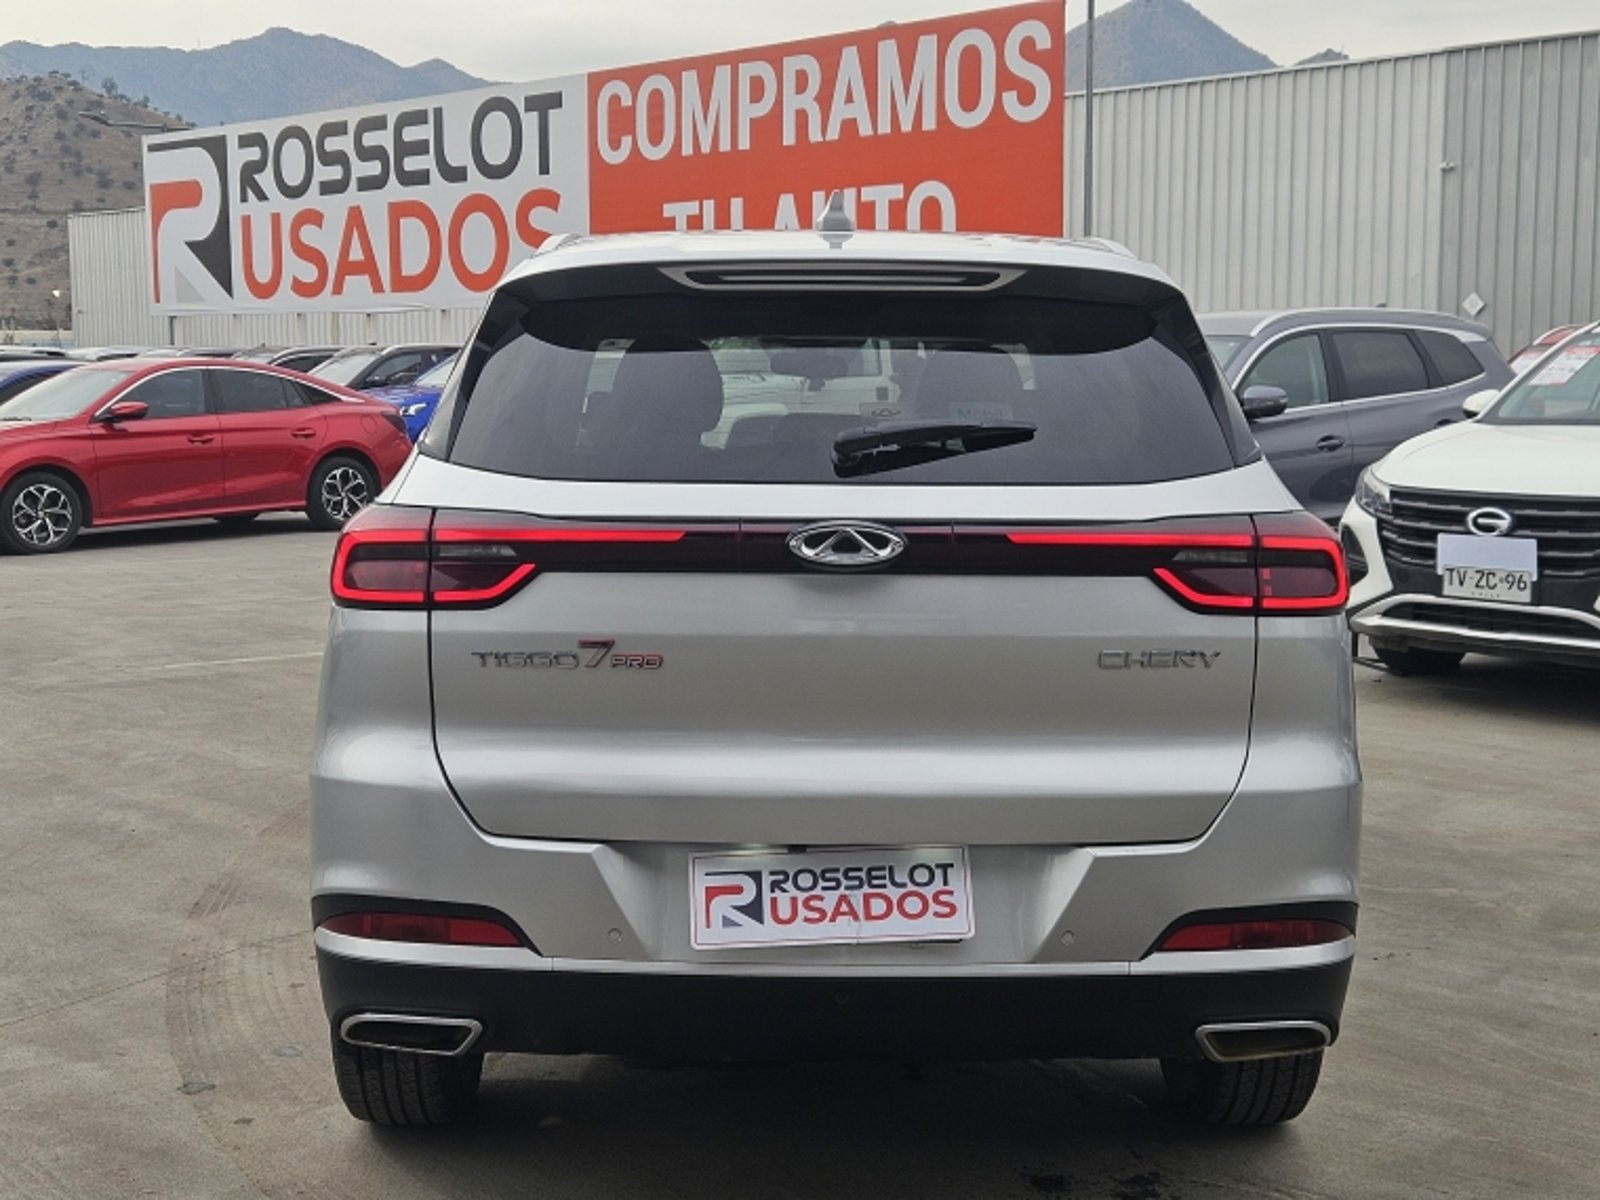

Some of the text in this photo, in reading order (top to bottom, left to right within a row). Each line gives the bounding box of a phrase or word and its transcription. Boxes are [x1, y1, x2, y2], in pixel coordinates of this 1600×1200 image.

[597, 19, 1052, 165] COMPRAMOS
[238, 91, 563, 202] ROSSELOT
[241, 188, 561, 300] USADOS
[471, 639, 664, 670] TIGGO 7 PRO
[1098, 650, 1221, 669] CHERY
[769, 862, 954, 894] ROSSELOT
[770, 889, 958, 926] USADOS
